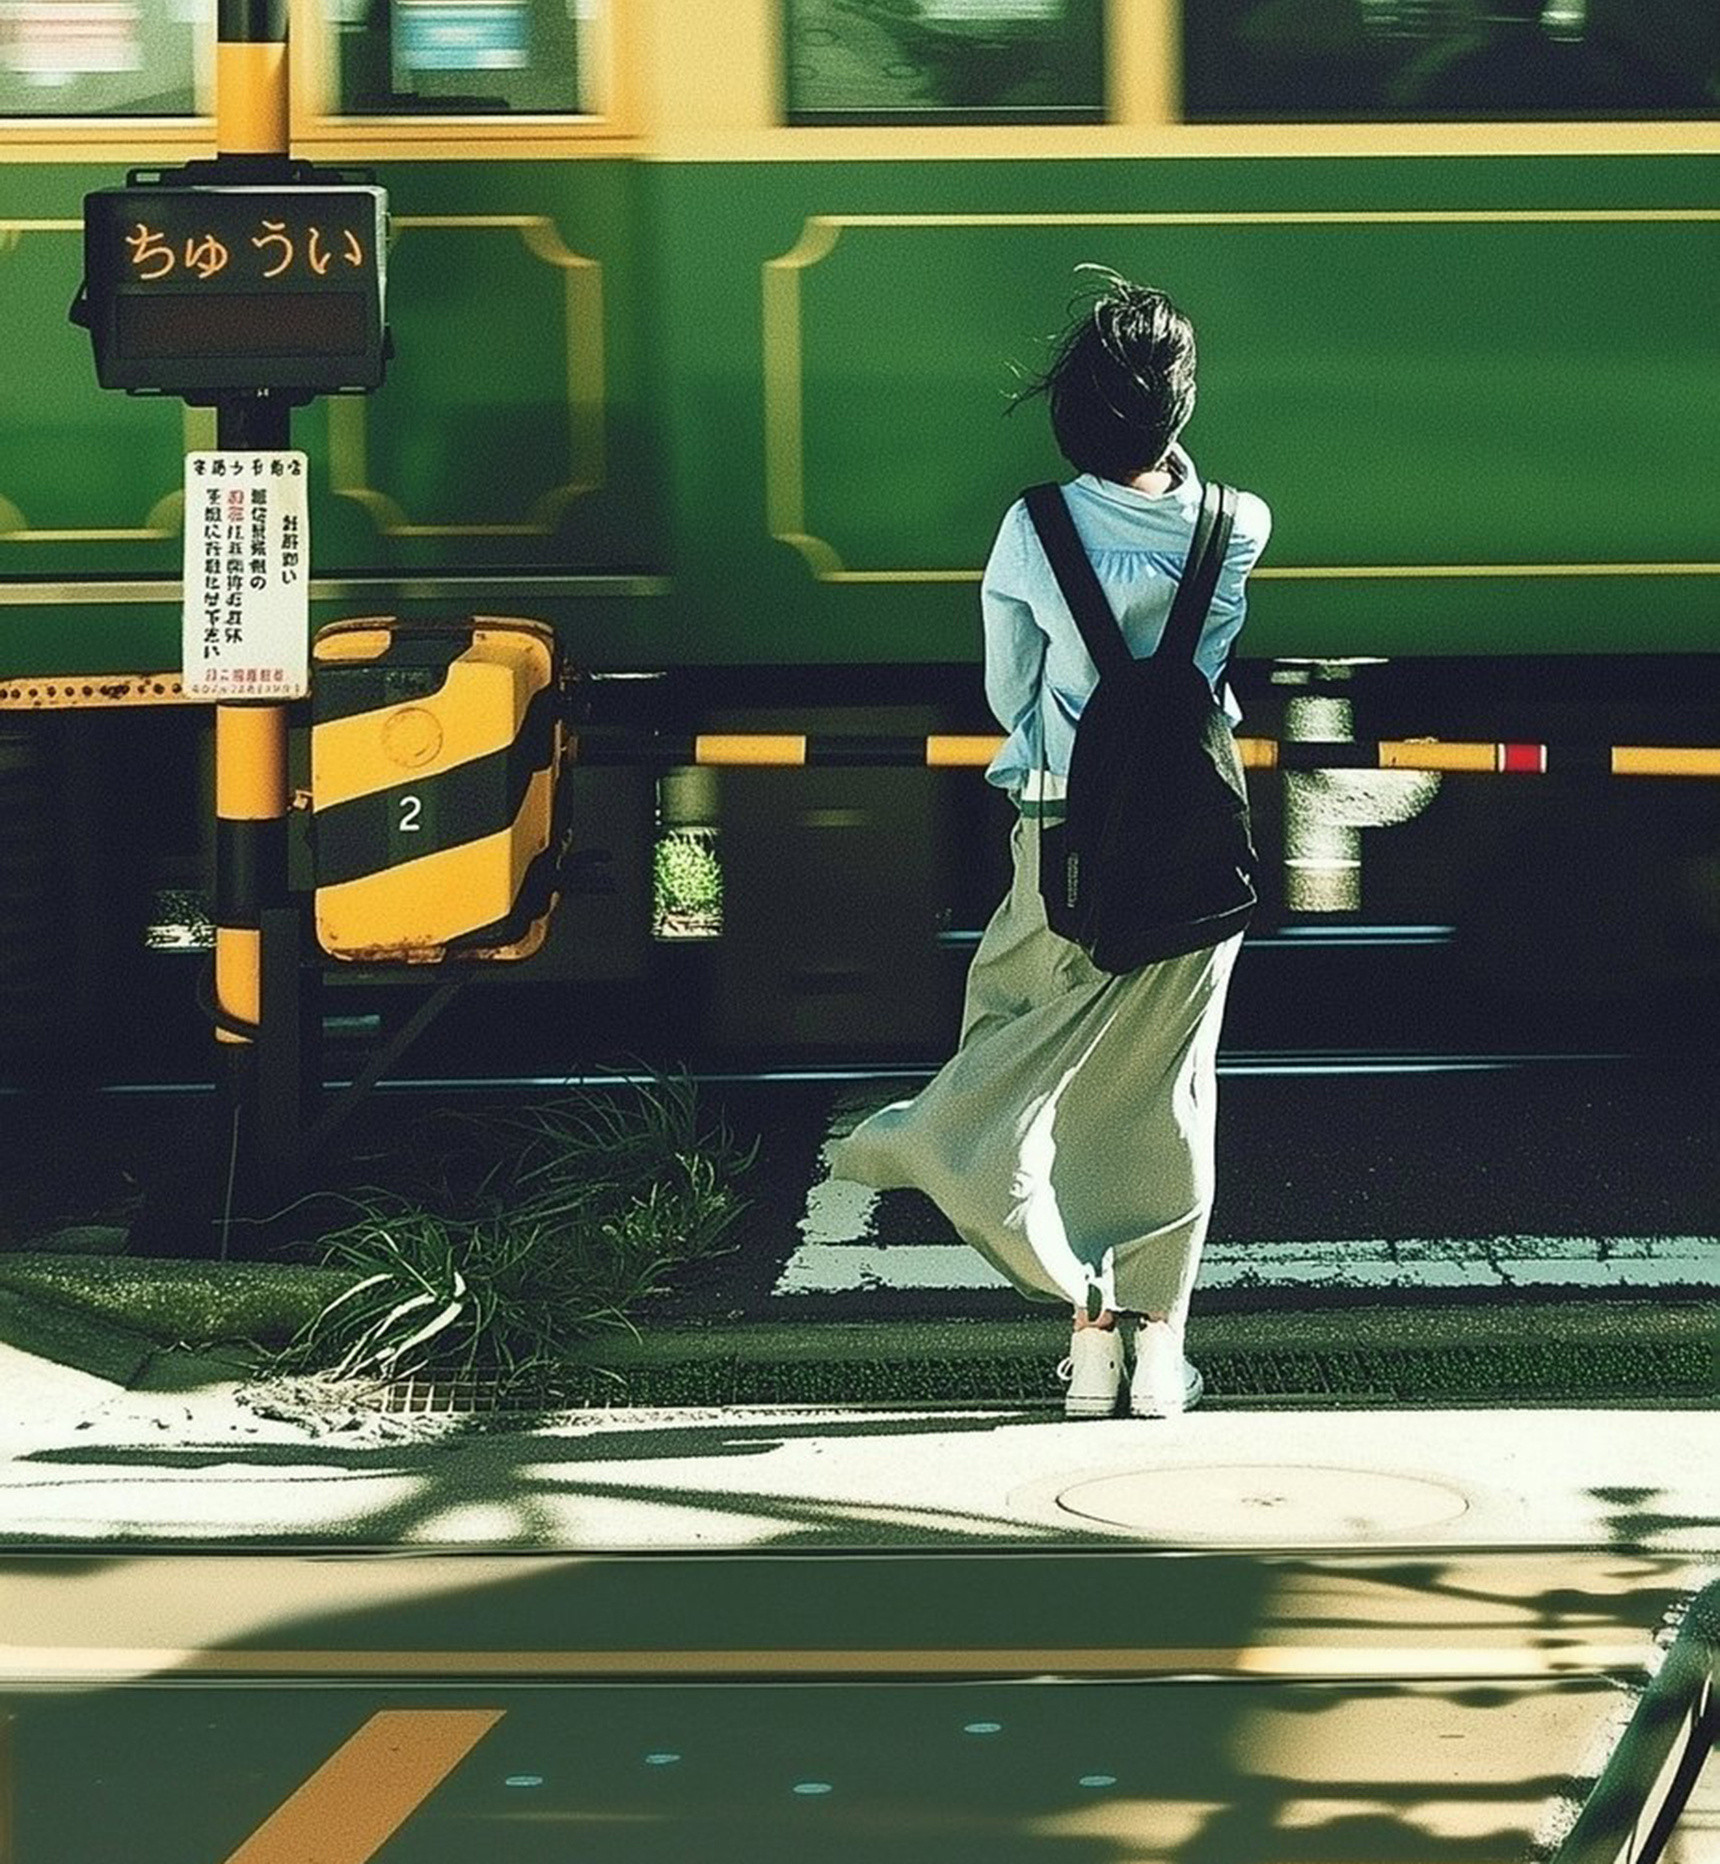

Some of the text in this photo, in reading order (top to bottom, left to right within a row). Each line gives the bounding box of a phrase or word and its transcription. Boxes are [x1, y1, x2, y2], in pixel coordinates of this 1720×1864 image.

[125, 220, 363, 280] ちゅうい
[399, 796, 422, 831] 2
